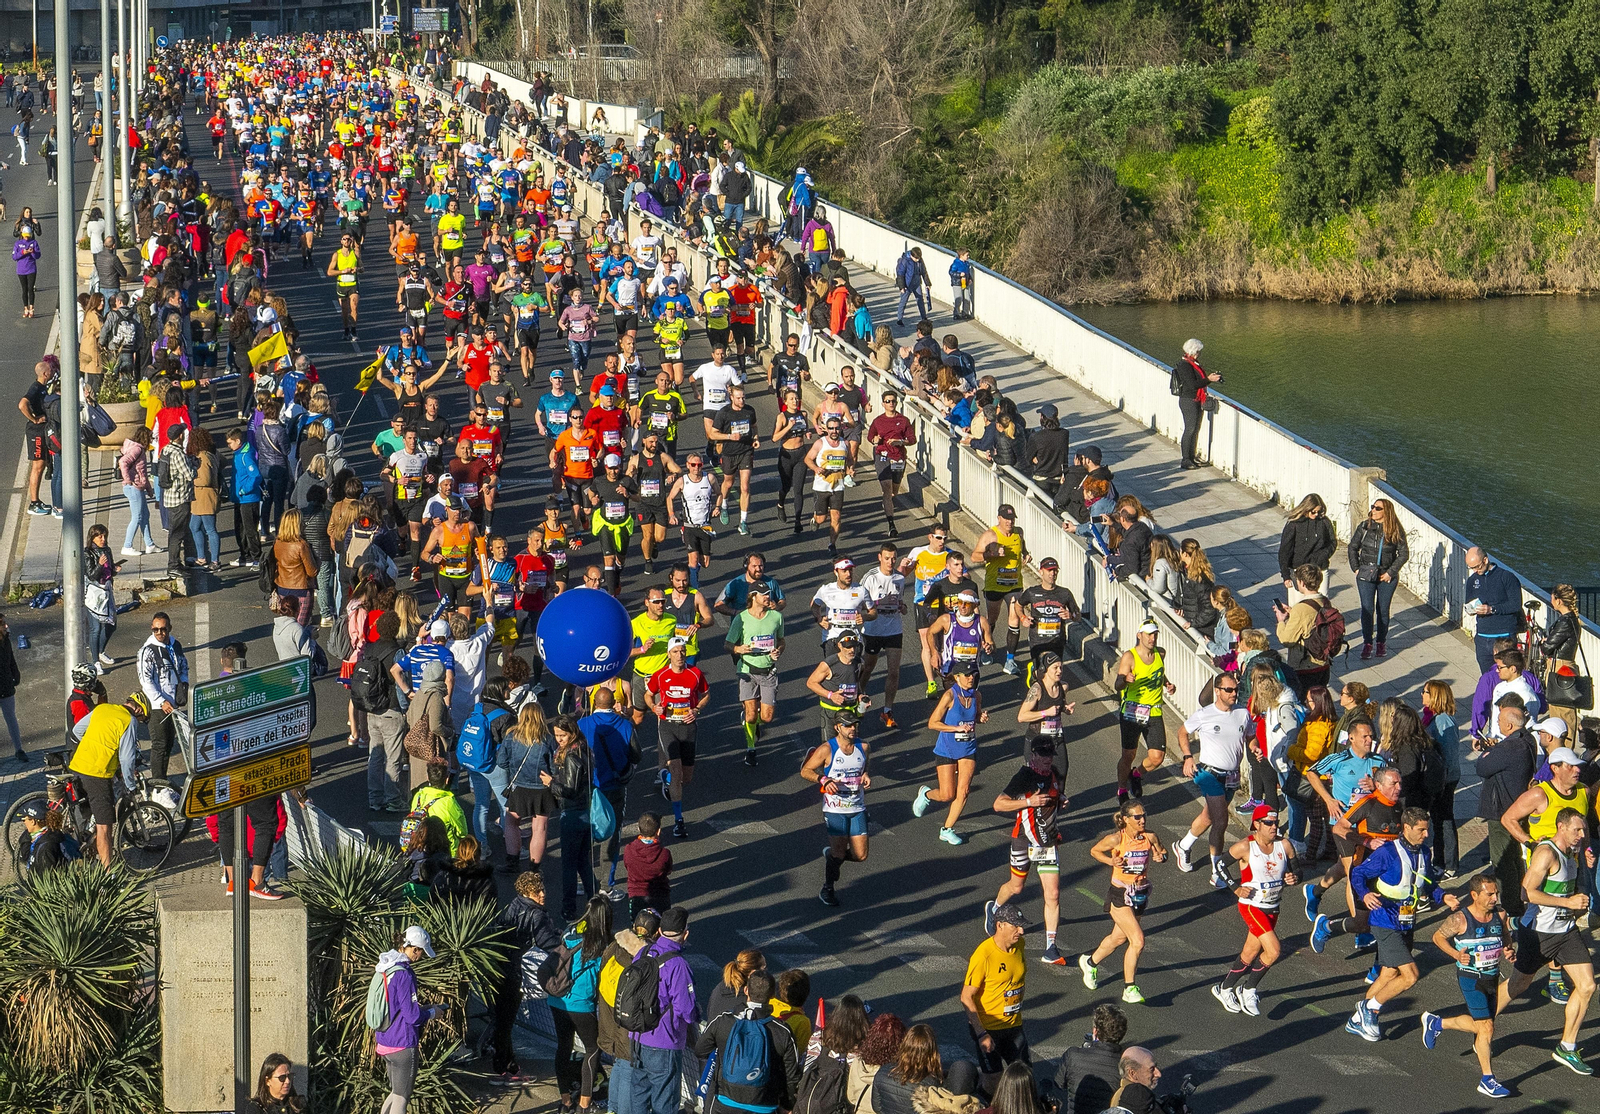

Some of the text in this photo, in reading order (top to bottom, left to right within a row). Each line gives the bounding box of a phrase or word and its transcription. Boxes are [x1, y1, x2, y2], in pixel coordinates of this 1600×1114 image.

[578, 661, 620, 673] ZURICH
[198, 684, 236, 704] puente de
[198, 692, 266, 720] Los Remedios
[277, 707, 307, 723] hospital
[231, 735, 261, 752] Virgen
[264, 728, 278, 743] del
[280, 753, 307, 770] Prado
[239, 783, 257, 798] San
